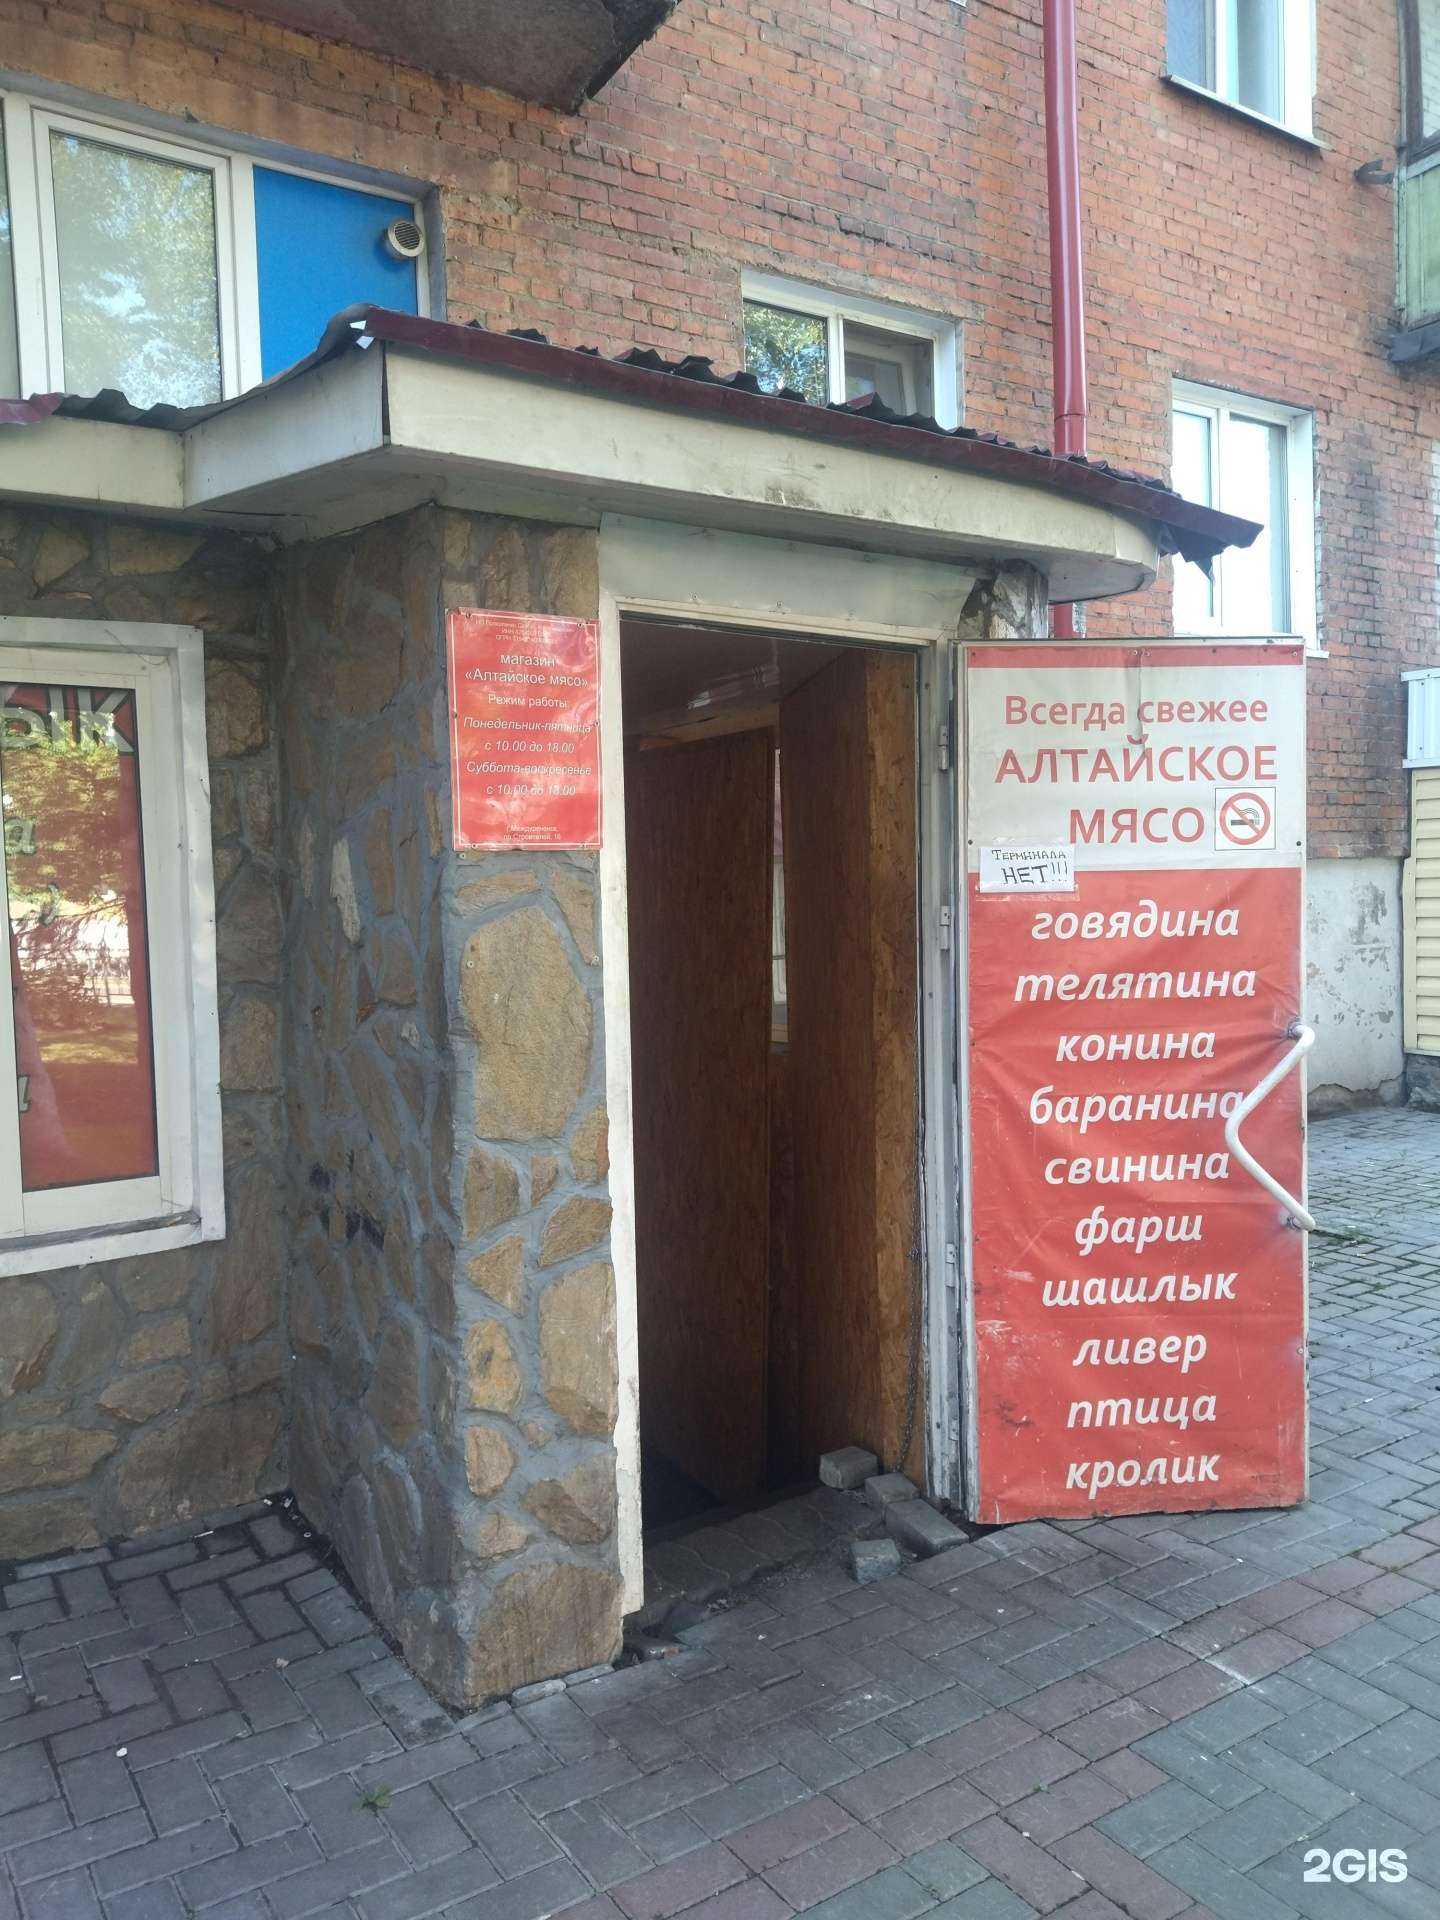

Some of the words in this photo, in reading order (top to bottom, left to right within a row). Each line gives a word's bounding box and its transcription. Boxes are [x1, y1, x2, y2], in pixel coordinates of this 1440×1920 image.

[465, 668, 546, 684] «Алтайское
[549, 674, 588, 687] мясо»
[500, 653, 556, 667] магазин
[488, 693, 526, 706] Режим
[1004, 695, 1126, 731] Всегда
[1137, 698, 1268, 723] свежее
[463, 716, 592, 734] Понедельник-пятница
[496, 740, 527, 752] 10.00
[529, 741, 543, 752] до
[547, 741, 575, 754] 18.00
[994, 733, 1279, 784] АЛТАЙСКОЕ
[1069, 807, 1205, 845] МЯСО
[1001, 861, 1068, 885] НЕТ!!!
[1031, 900, 1240, 940] говядина
[1014, 969, 1257, 1002] телятина
[1055, 1031, 1217, 1062] конина
[1030, 1085, 1246, 1134] баранина
[1044, 1151, 1230, 1185] свинина
[1075, 1205, 1203, 1256] фарш
[1042, 1272, 1239, 1307] шашлык
[1072, 1333, 1207, 1373] ливер
[1067, 1395, 1217, 1430] птица
[1065, 1454, 1221, 1499] кролик
